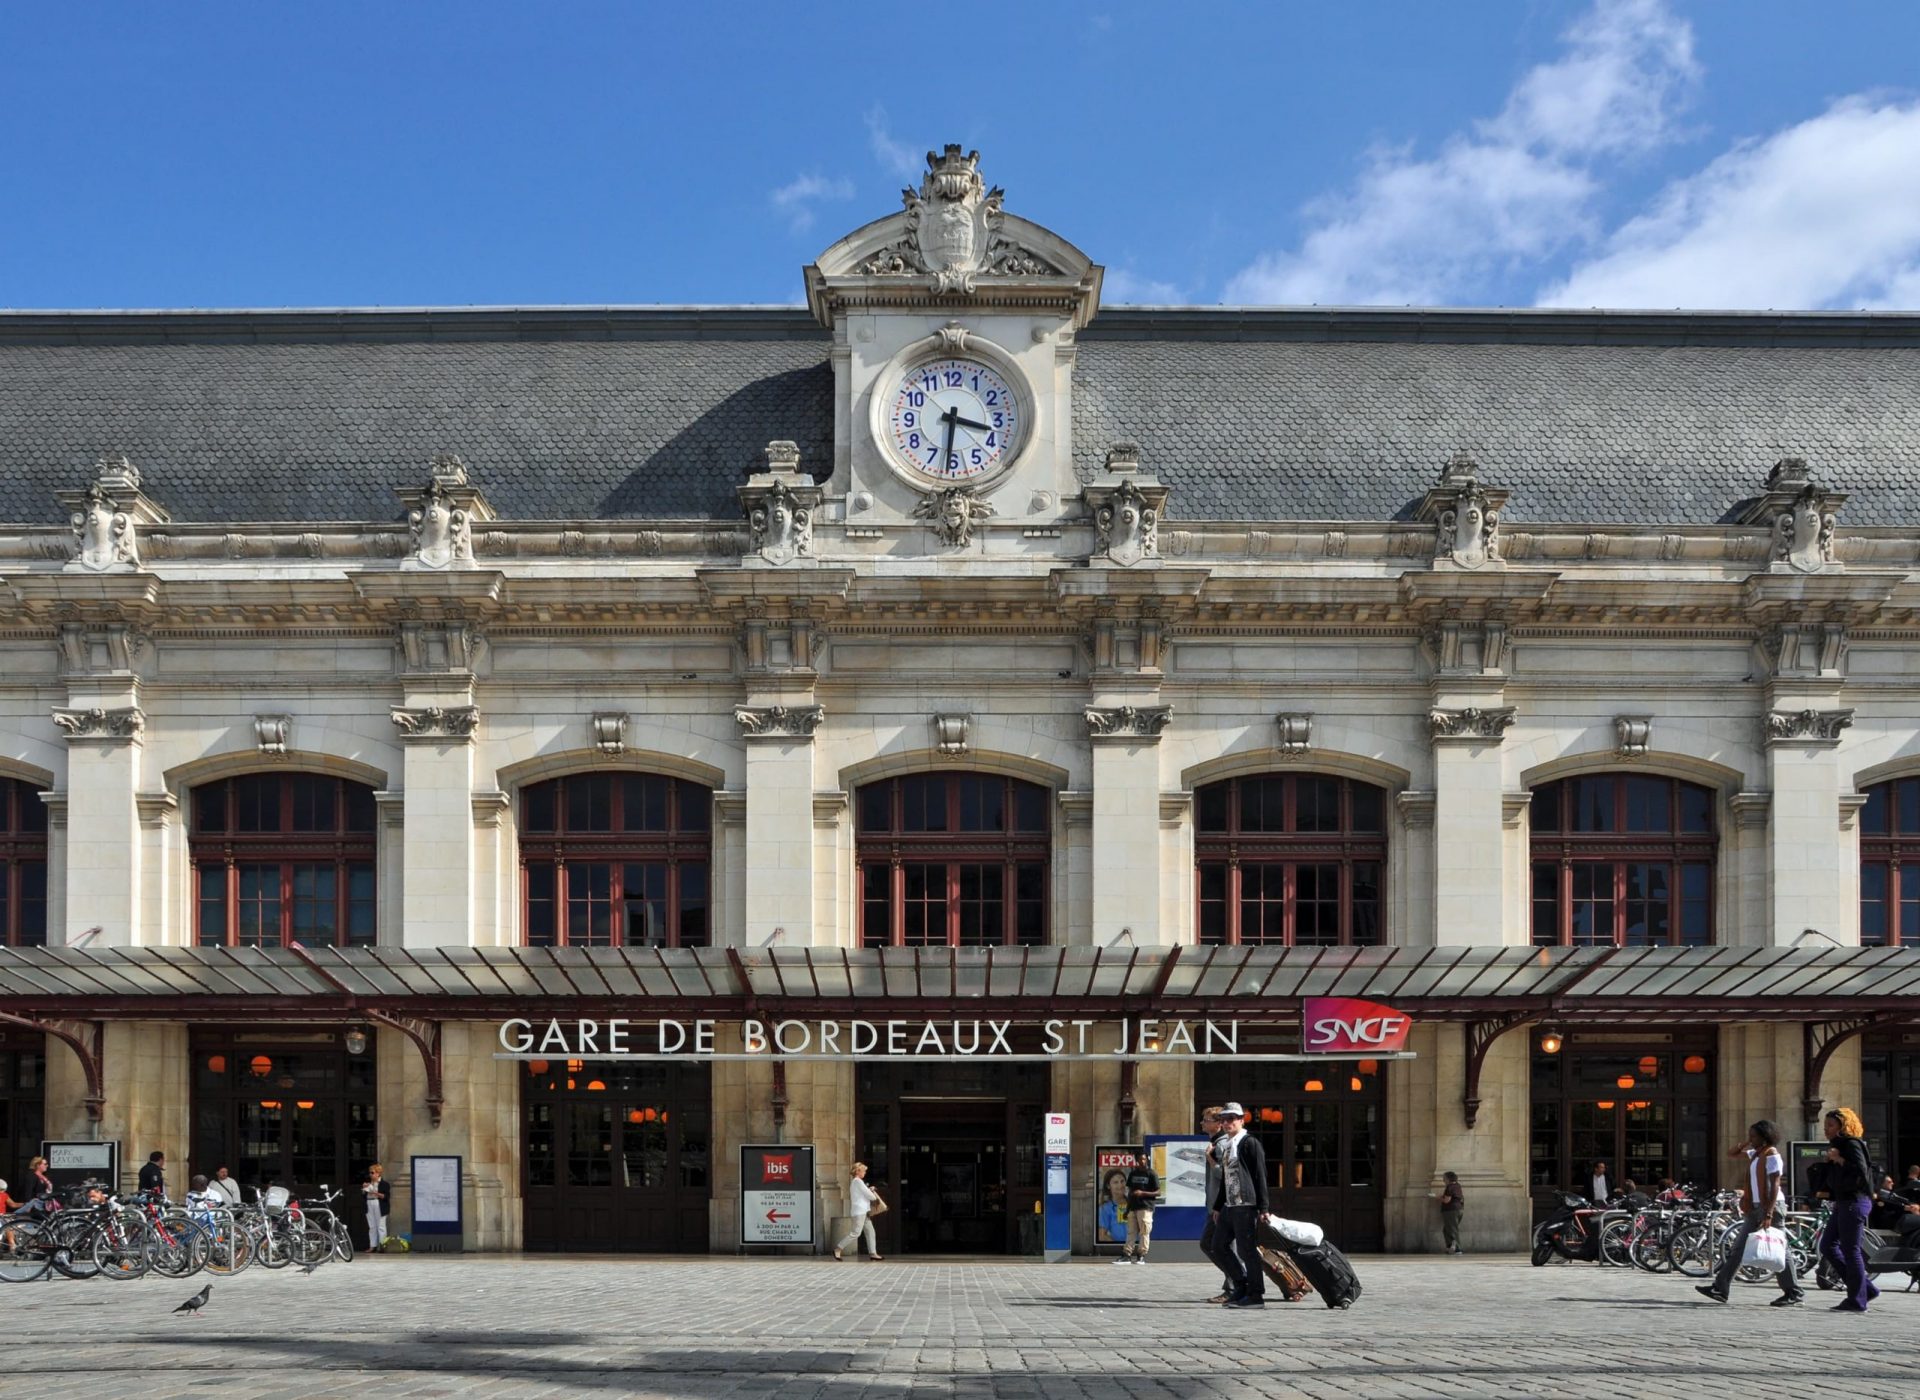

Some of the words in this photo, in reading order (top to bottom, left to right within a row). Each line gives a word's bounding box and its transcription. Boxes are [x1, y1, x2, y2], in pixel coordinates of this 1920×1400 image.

[923, 376, 937, 391] 11
[944, 371, 963, 387] 12
[971, 376, 978, 391] 1
[906, 392, 924, 407] 10
[986, 390, 997, 406] 2
[904, 412, 914, 427] 9
[993, 412, 1003, 428] 3
[909, 433, 920, 449] 8
[985, 432, 996, 448] 4
[927, 448, 938, 464] 7
[950, 454, 958, 469] 6
[971, 449, 981, 465] 5
[499, 1017, 630, 1053] GARE
[658, 1019, 716, 1053] DE
[744, 1019, 1013, 1054] BORDEAUX
[1041, 1019, 1093, 1054] ST
[1114, 1018, 1238, 1054] JEAN
[1309, 1017, 1405, 1045] SNCF
[767, 1162, 789, 1174] ibis
